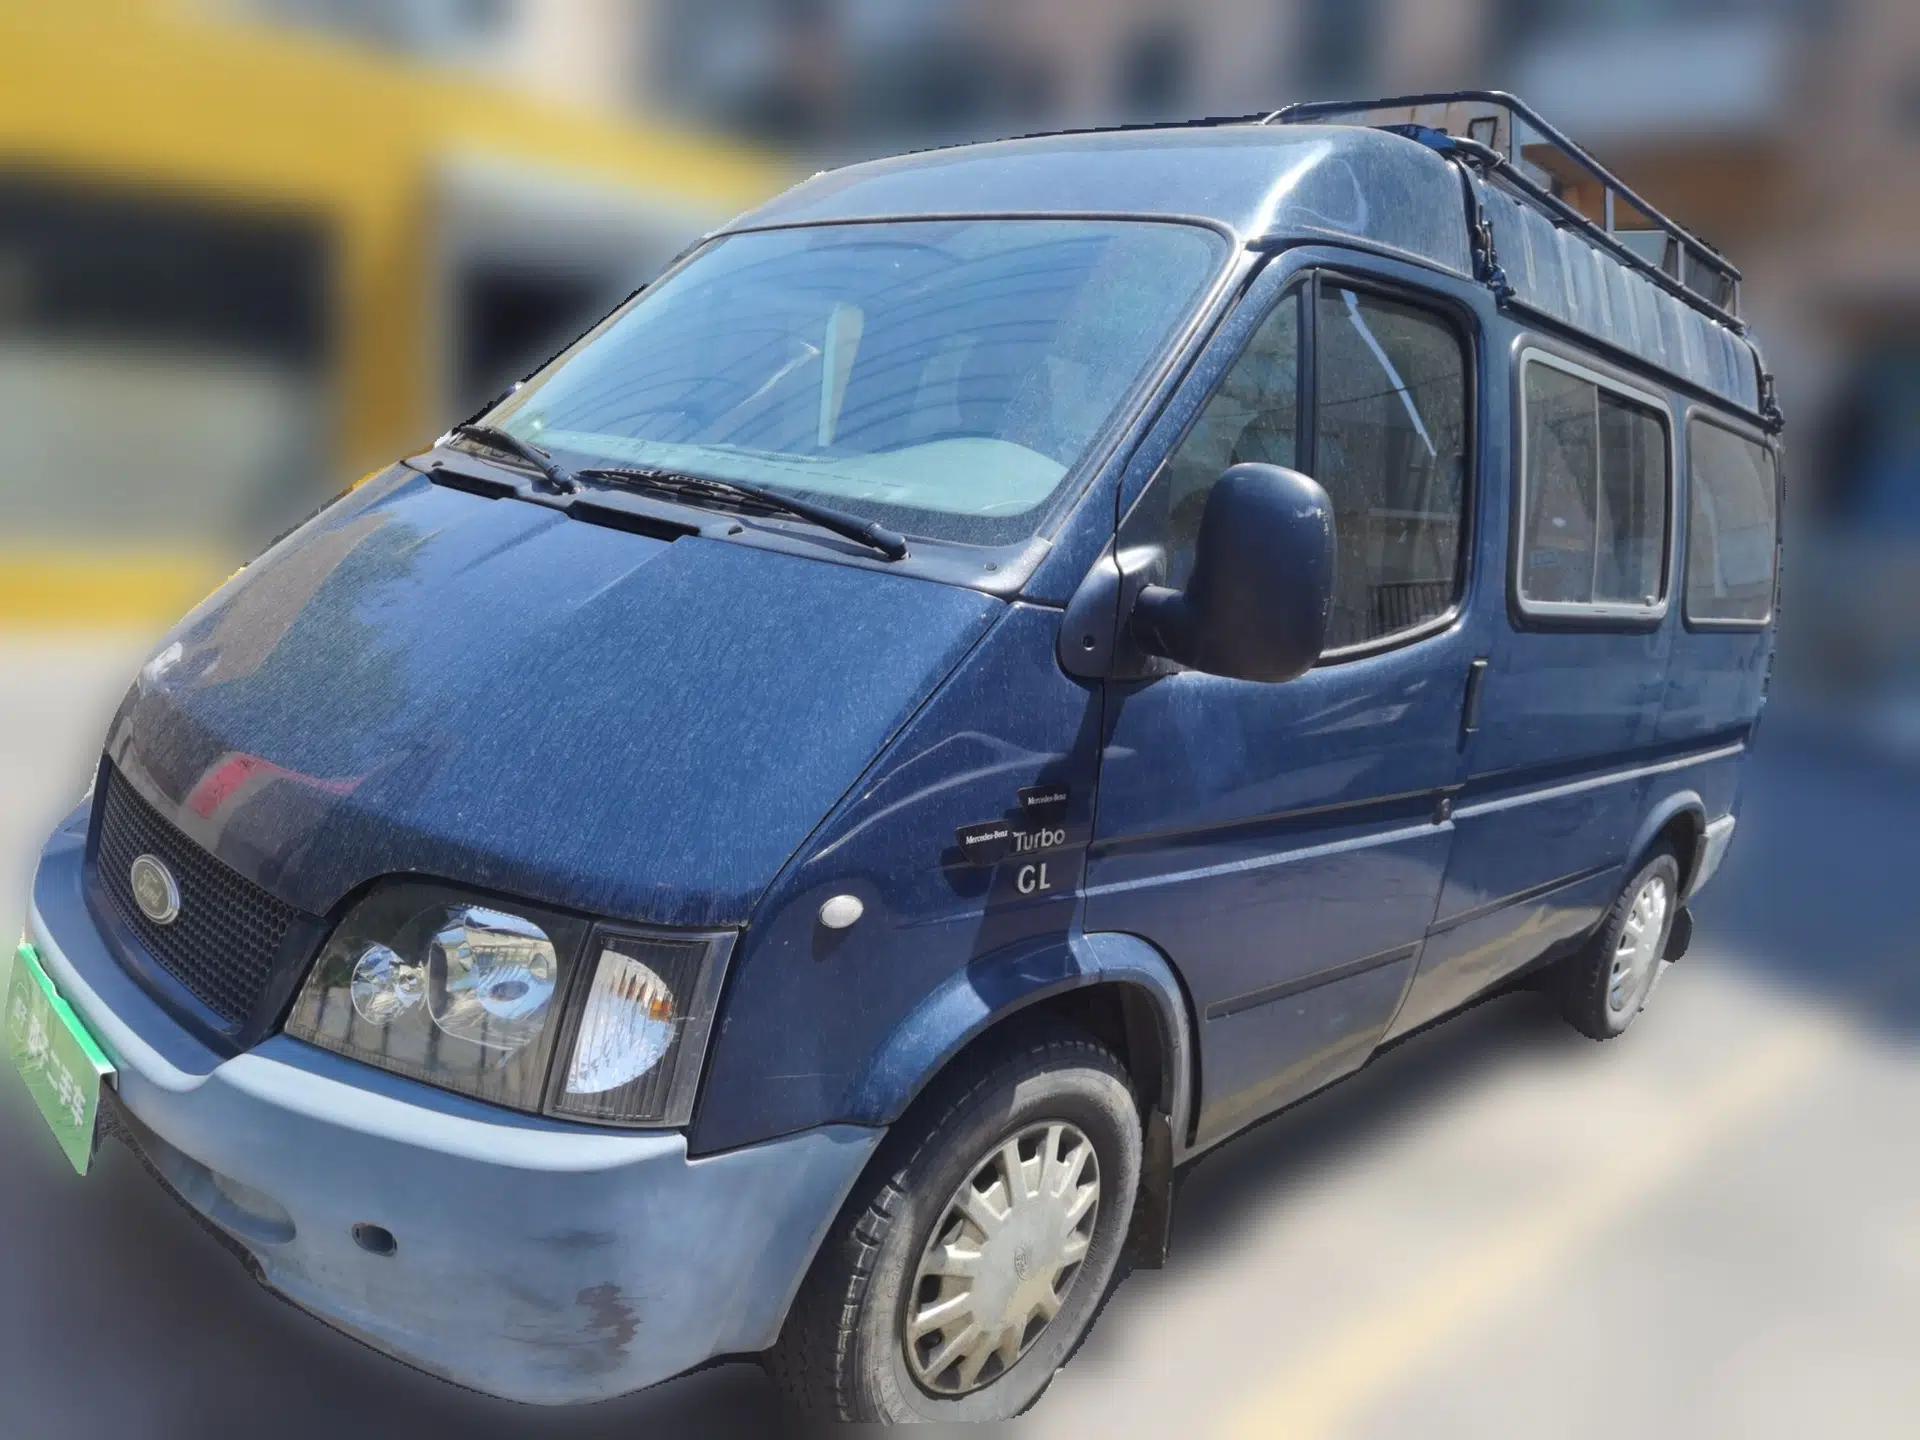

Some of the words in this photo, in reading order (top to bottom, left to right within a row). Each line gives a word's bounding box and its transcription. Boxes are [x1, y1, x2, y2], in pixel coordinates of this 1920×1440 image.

[1027, 793, 1067, 806] Mercedes-Benz
[965, 830, 1008, 845] Mercedes-Benz
[1013, 827, 1066, 852] Turbo
[1017, 862, 1051, 894] CL
